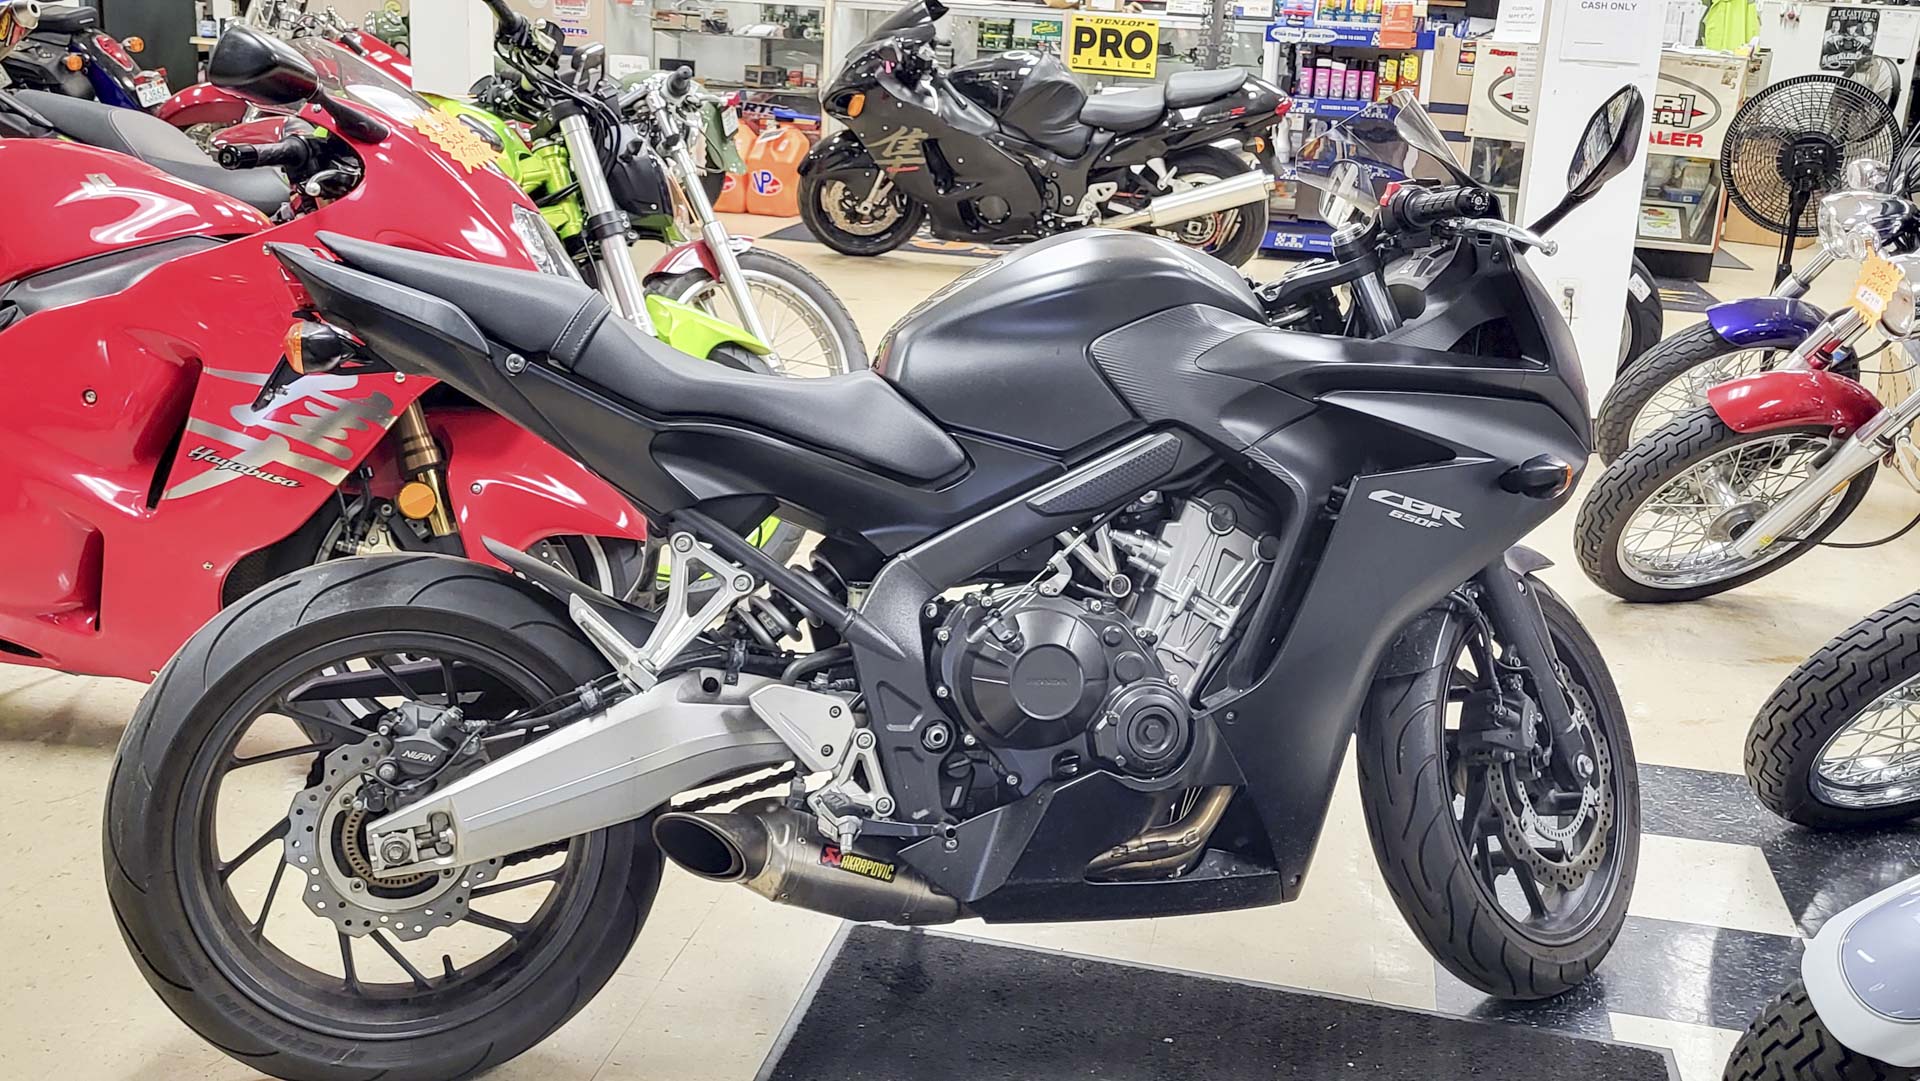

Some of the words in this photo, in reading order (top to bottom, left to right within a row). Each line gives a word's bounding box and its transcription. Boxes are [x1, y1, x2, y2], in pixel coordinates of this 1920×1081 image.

[1581, 1, 1608, 10] CASH
[1610, 2, 1637, 11] ONLY
[560, 27, 588, 35] ARTS
[1096, 18, 1145, 27] DUNLOP
[1073, 26, 1153, 60] PRO
[1072, 58, 1151, 69] DEALER
[753, 171, 772, 194] VP
[188, 445, 304, 488] Hayabusa
[1368, 489, 1465, 529] CBR
[1388, 509, 1444, 528] 650F
